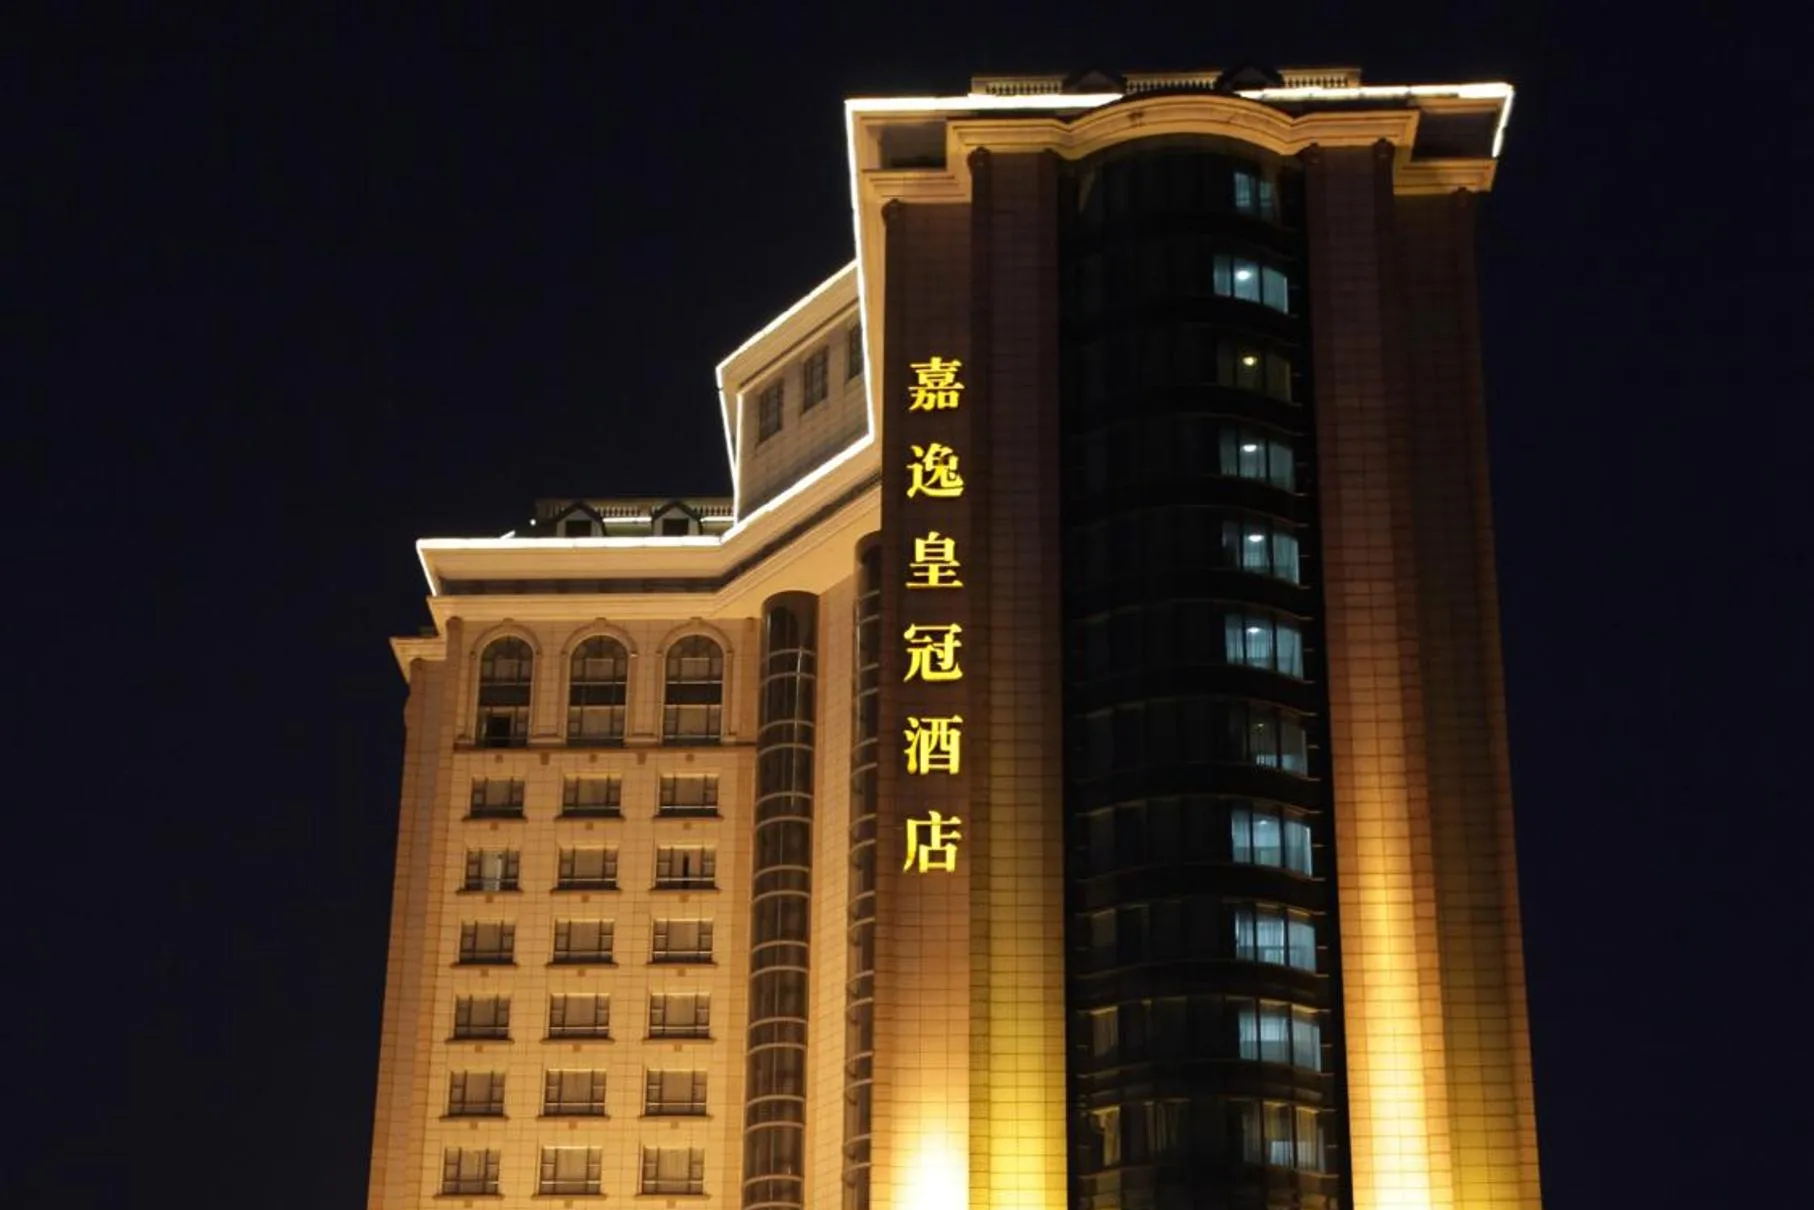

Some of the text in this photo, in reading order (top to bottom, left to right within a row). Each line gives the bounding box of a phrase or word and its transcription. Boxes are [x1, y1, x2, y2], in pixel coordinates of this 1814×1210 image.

[903, 356, 965, 873] 嘉逸皇冠酒店
